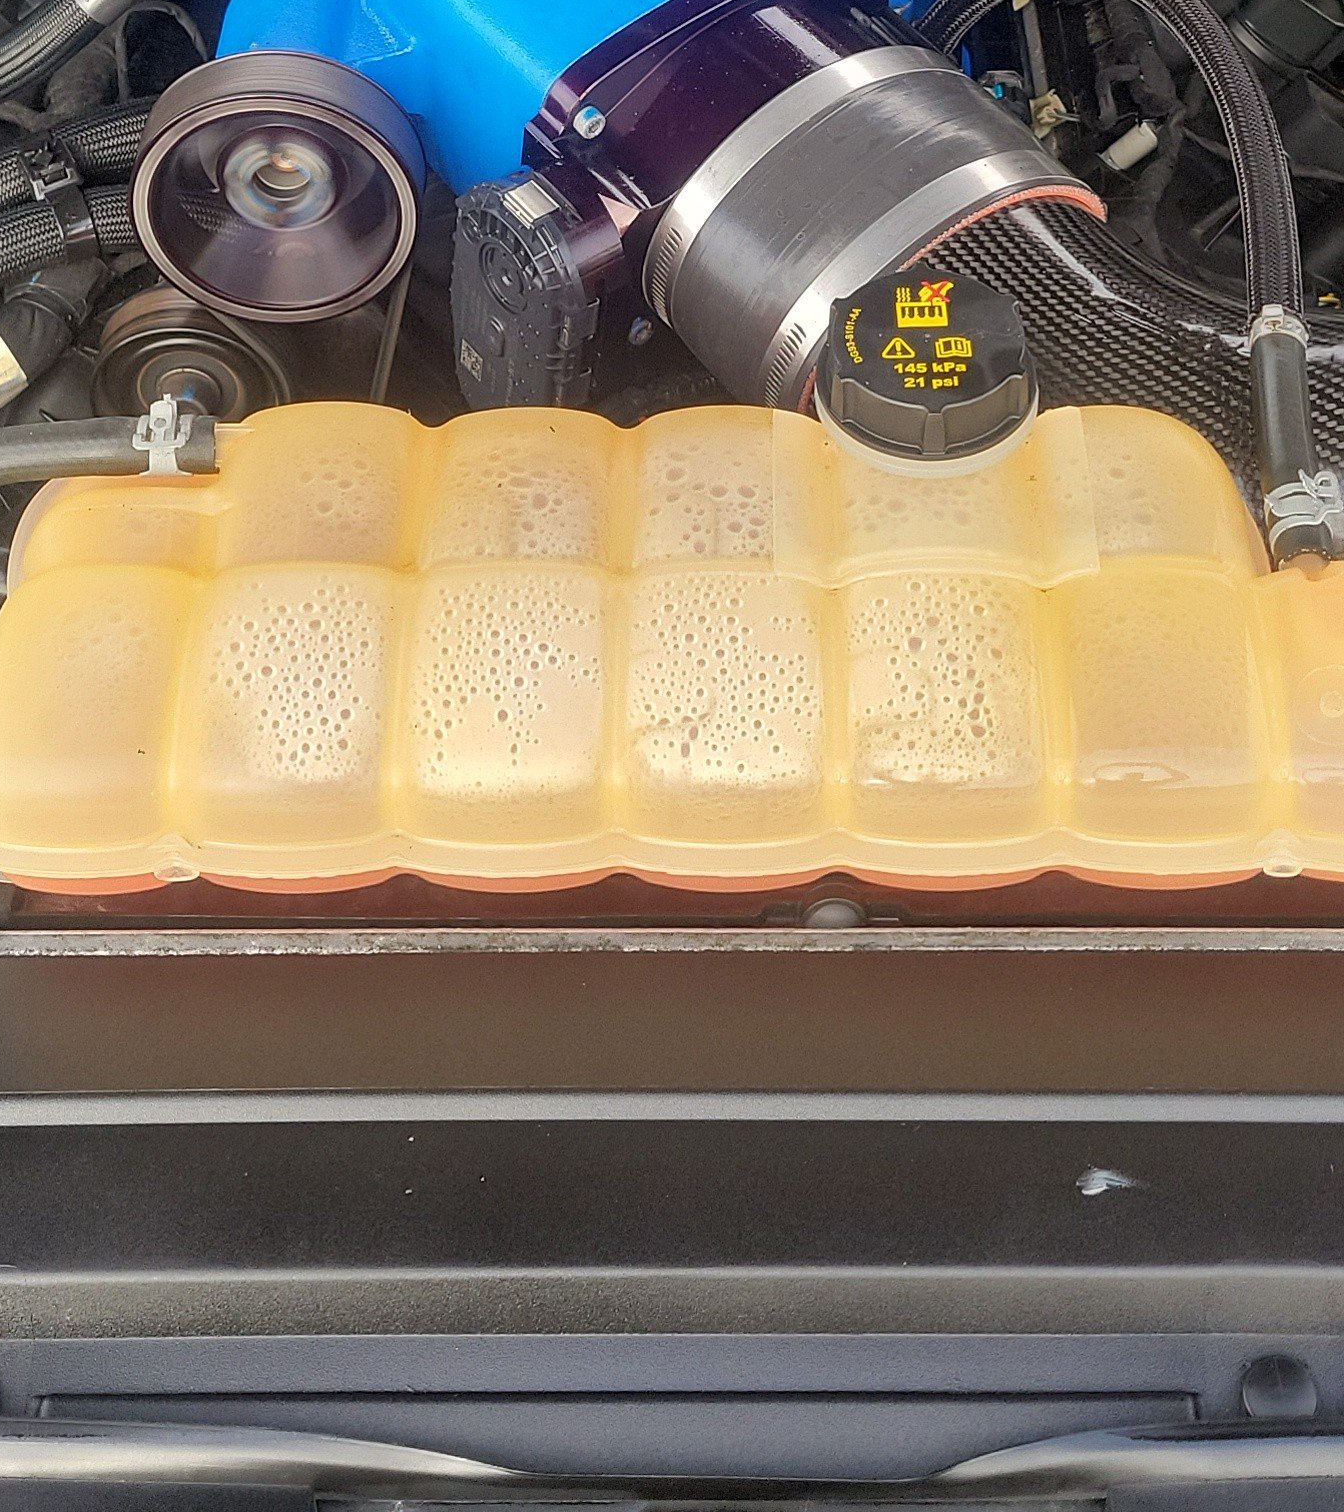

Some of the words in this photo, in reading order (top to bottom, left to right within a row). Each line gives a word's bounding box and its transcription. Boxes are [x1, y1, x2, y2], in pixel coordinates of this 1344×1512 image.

[894, 362, 927, 374] 145
[931, 362, 967, 374] kPa
[904, 377, 924, 388] 21
[932, 377, 959, 390] psi
